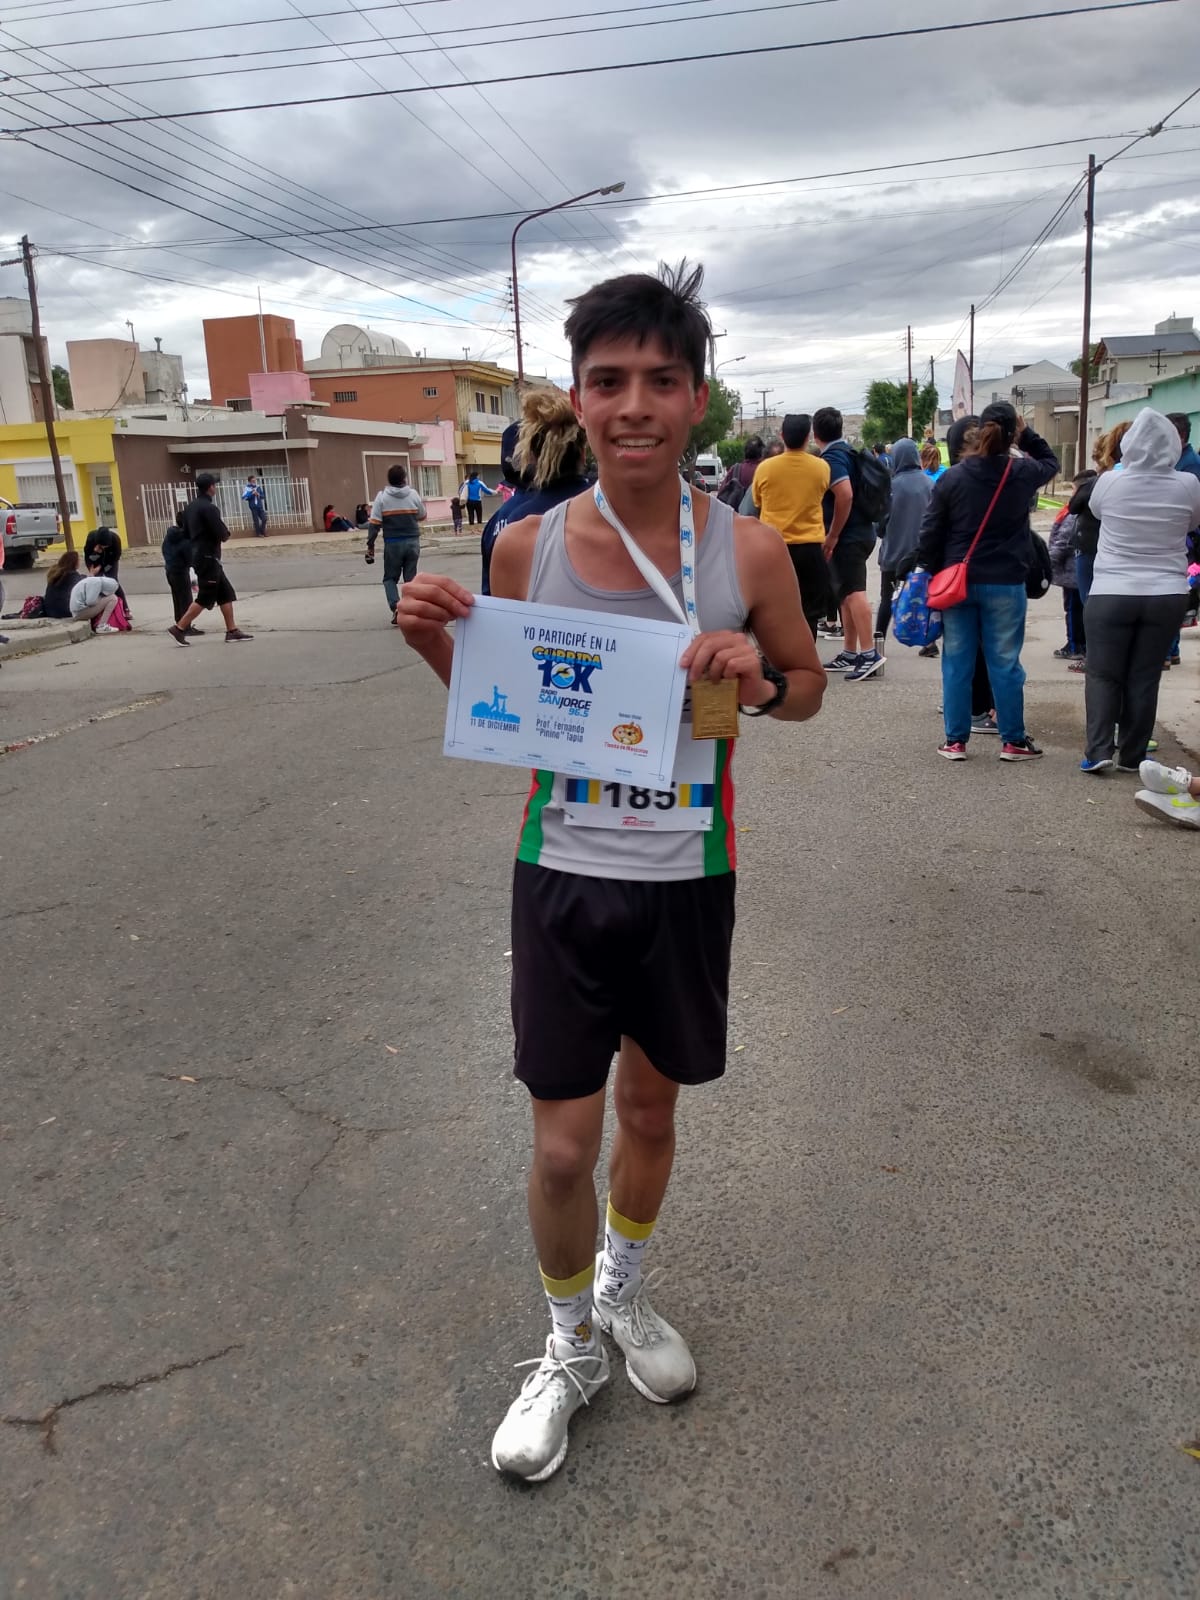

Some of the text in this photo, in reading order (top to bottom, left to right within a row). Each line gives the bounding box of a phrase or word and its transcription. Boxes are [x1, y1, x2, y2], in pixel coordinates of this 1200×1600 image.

[523, 626, 617, 653] YO PARTICIPÉ EN LA
[532, 645, 603, 670] CURRIDA
[537, 661, 595, 694] 10K
[568, 707, 590, 717] 96.5
[470, 718, 520, 733] 11 DE DICIEMBRE
[554, 721, 585, 734] Fernando
[566, 732, 584, 743] Tapia
[603, 781, 677, 810] 185
